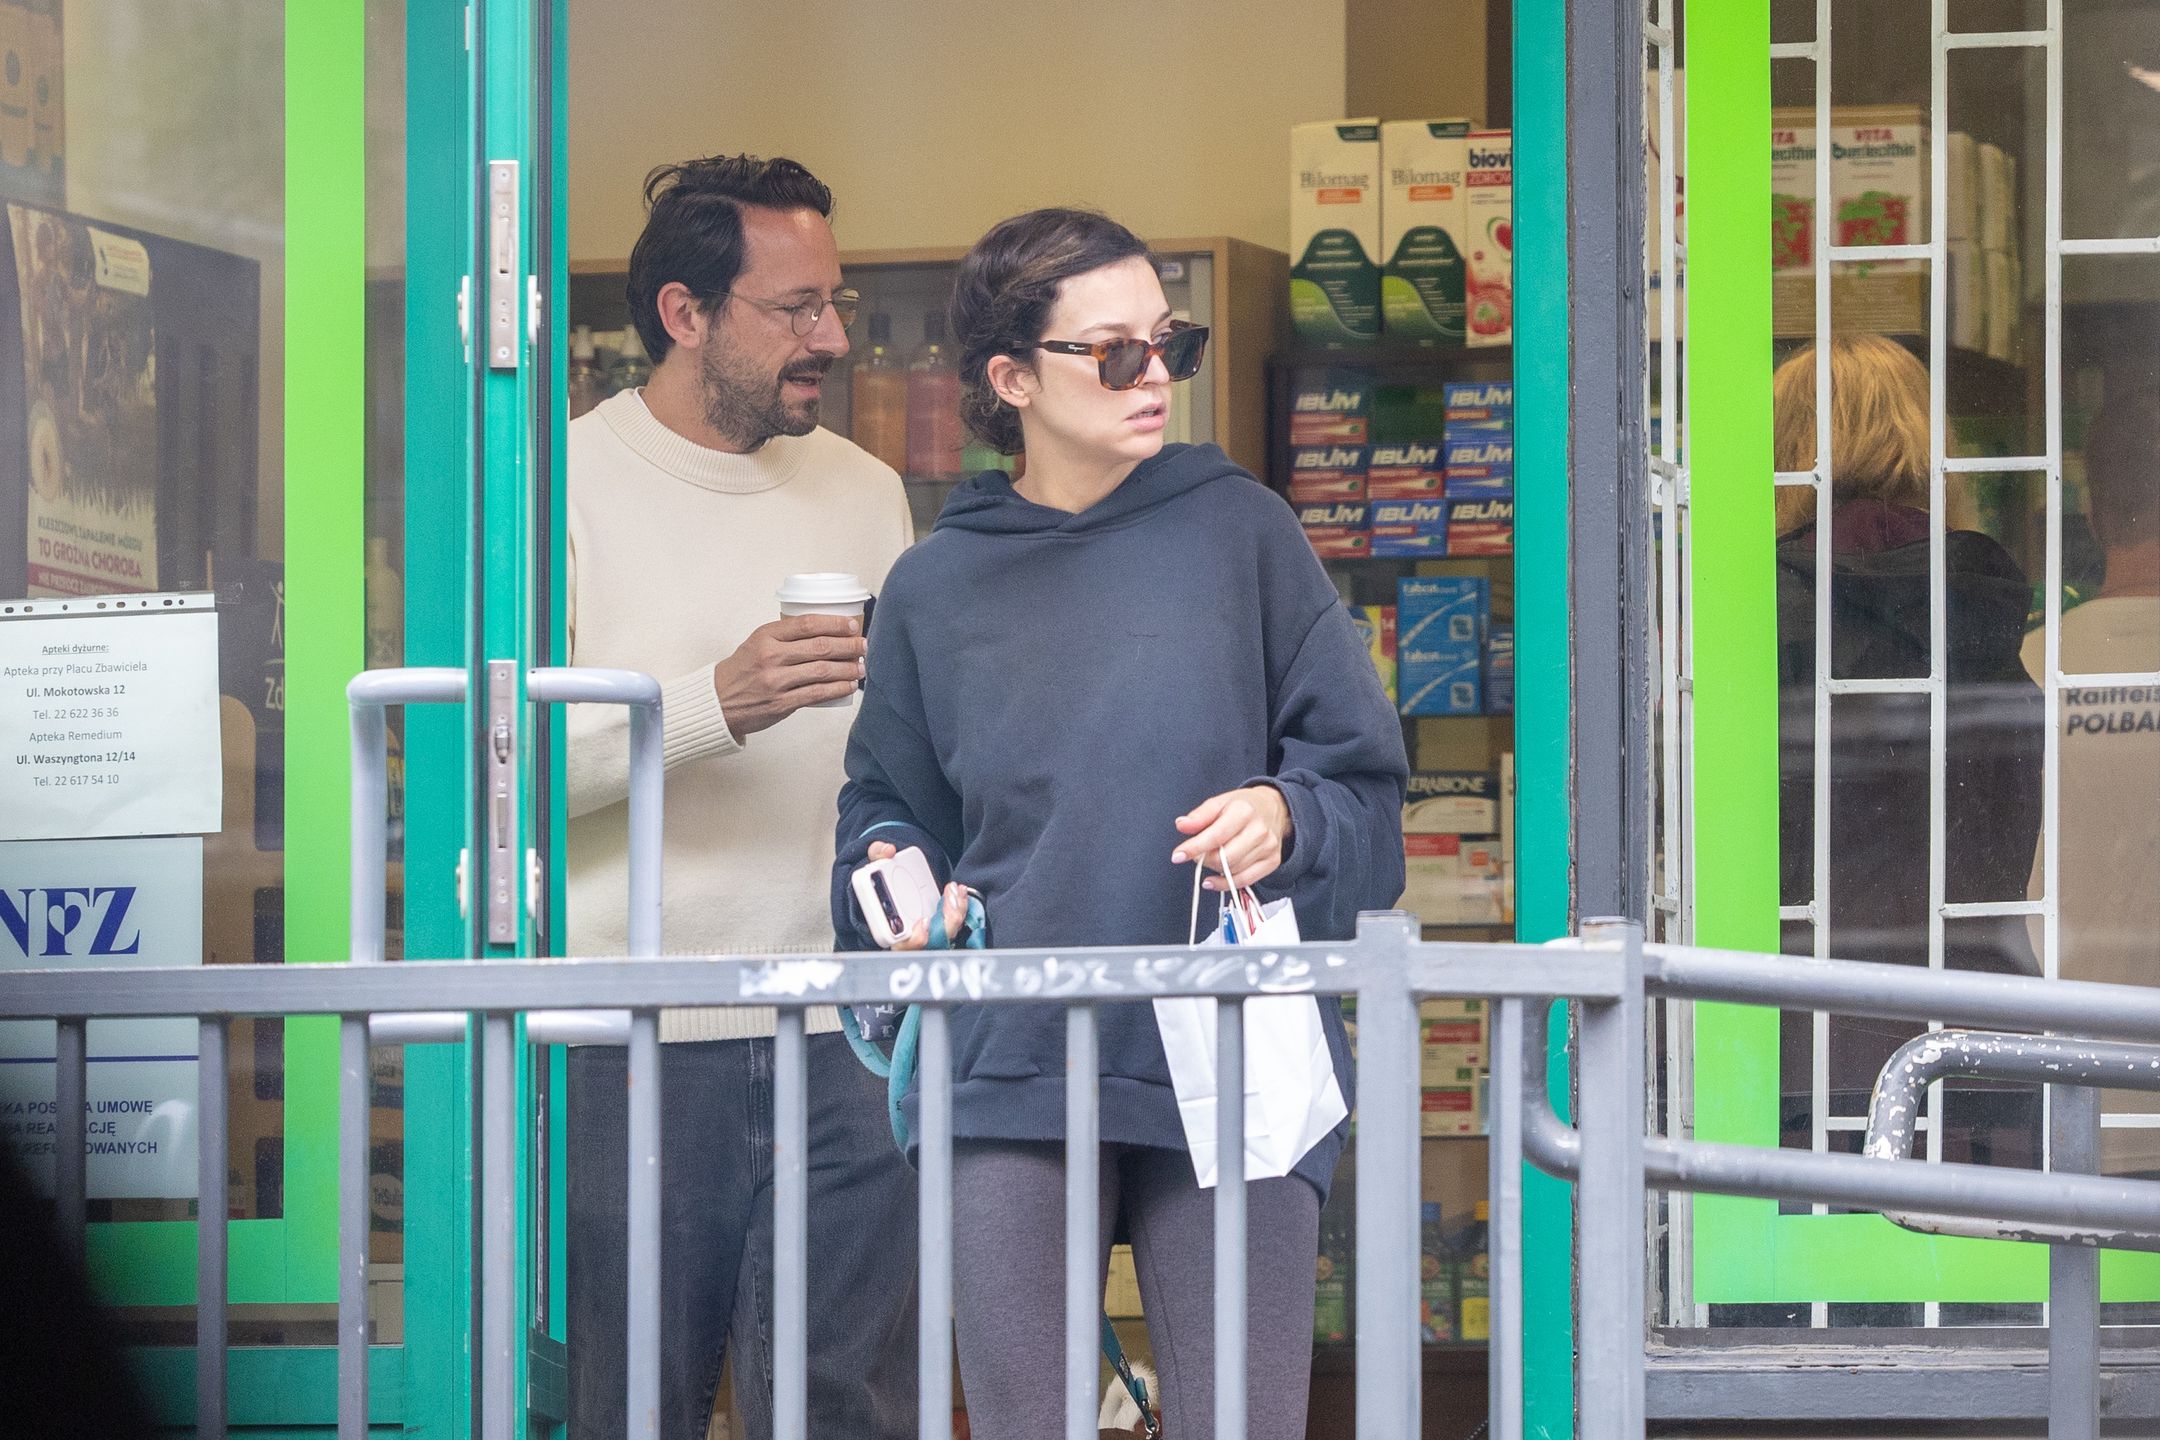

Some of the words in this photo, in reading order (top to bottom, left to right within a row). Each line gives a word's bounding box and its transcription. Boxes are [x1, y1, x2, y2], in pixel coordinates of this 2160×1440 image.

[1296, 389, 1361, 411] IBUM
[1295, 449, 1360, 467] IBUM
[1371, 443, 1438, 465] IBUM
[1300, 504, 1365, 523] IBUM
[1376, 503, 1440, 521] IBUM
[39, 537, 51, 558] TO
[42, 645, 70, 655] Apteki
[72, 643, 110, 654] dyżurne:
[4, 666, 39, 677] Apteka
[42, 665, 63, 676] przy
[66, 663, 93, 674] Placu
[95, 661, 148, 673] Zbawiciela
[26, 688, 40, 698] Ul.
[44, 685, 110, 697] Mokotowska
[113, 685, 126, 695] 12
[33, 710, 51, 720] Tel.
[54, 709, 67, 720] 22
[69, 708, 88, 719] 622
[91, 708, 104, 718] 36
[106, 707, 119, 718] 36
[29, 732, 65, 743] Apteka
[68, 729, 122, 741] Remedium
[16, 755, 31, 765] Ul.
[34, 752, 102, 765] Waszyngtona
[106, 750, 136, 763] 12/14
[33, 777, 51, 787] Tel.
[54, 776, 67, 786] 22
[70, 775, 88, 785] 617
[91, 775, 104, 785] 54
[107, 774, 119, 784] 10
[1408, 776, 1486, 794] ERABIONE
[0, 887, 140, 957] NFZ
[97, 1101, 153, 1115] UMOWĘ
